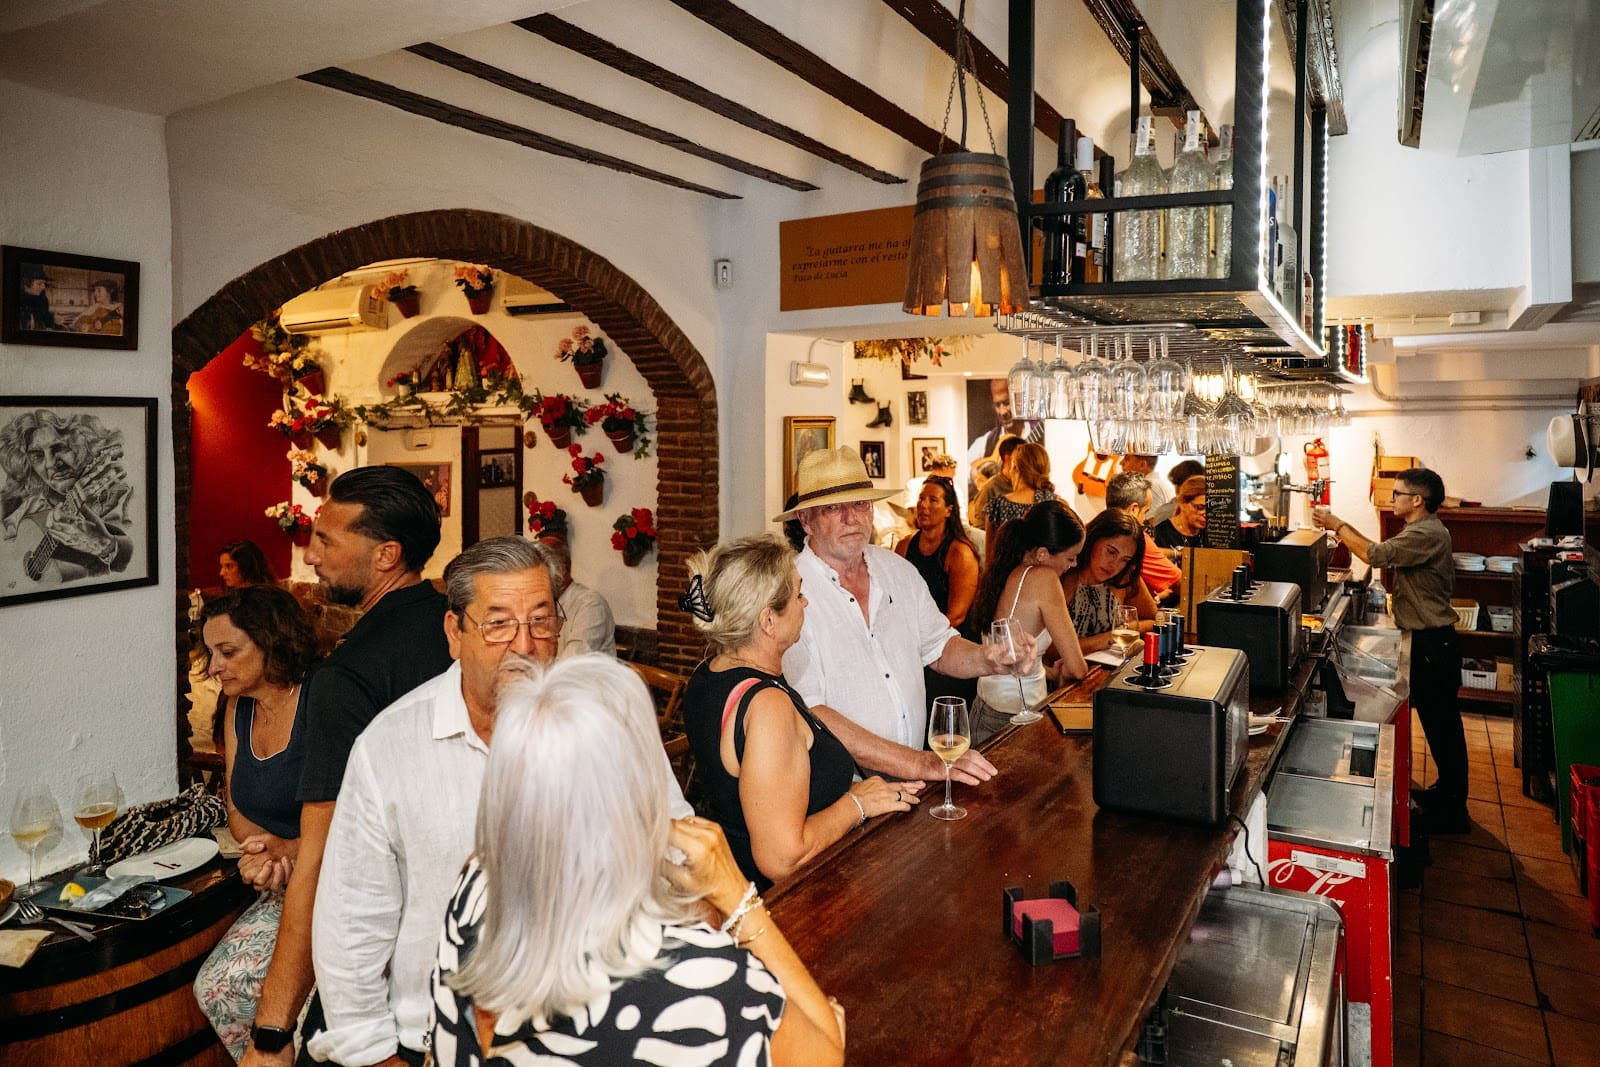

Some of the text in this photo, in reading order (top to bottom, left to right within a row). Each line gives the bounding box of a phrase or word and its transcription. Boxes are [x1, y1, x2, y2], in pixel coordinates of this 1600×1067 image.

[823, 243, 865, 258] guitarra
[868, 241, 883, 250] me
[886, 239, 899, 249] ha
[792, 251, 908, 271] expresarme con el resto
